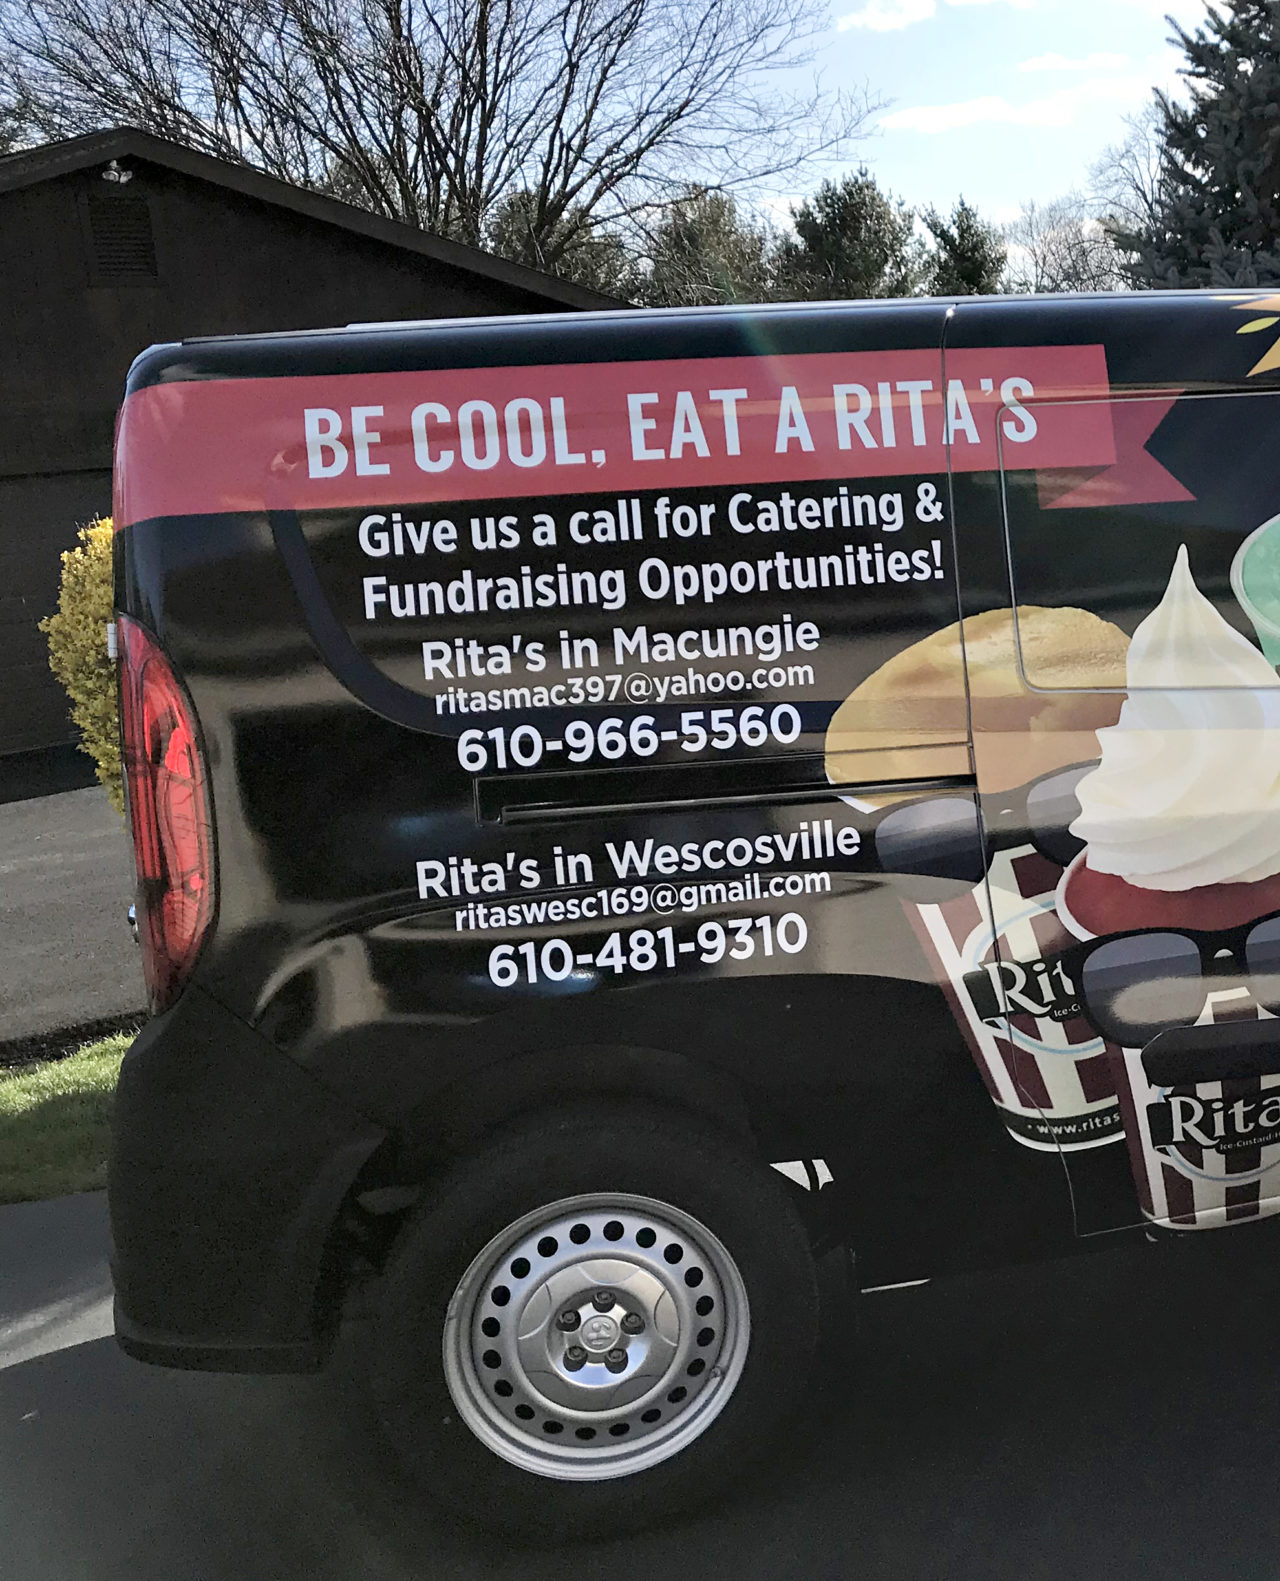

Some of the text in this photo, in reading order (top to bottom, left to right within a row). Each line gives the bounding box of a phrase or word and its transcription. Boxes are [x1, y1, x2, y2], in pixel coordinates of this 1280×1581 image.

[304, 376, 1037, 478] BE COOL, EAT A RITA'S
[359, 482, 944, 557] Give us a call for Catering &
[363, 539, 944, 619] Fundraising Opportunities!
[422, 614, 820, 680] Rita's in Macungie
[435, 664, 814, 714] ritasmac397@yahoo.com
[457, 703, 801, 772] 610-966-5560
[416, 819, 860, 899] Rita's in Wescosville
[455, 872, 830, 931] ritaswesc169@gmail.com
[489, 912, 807, 987] 610-481-9310
